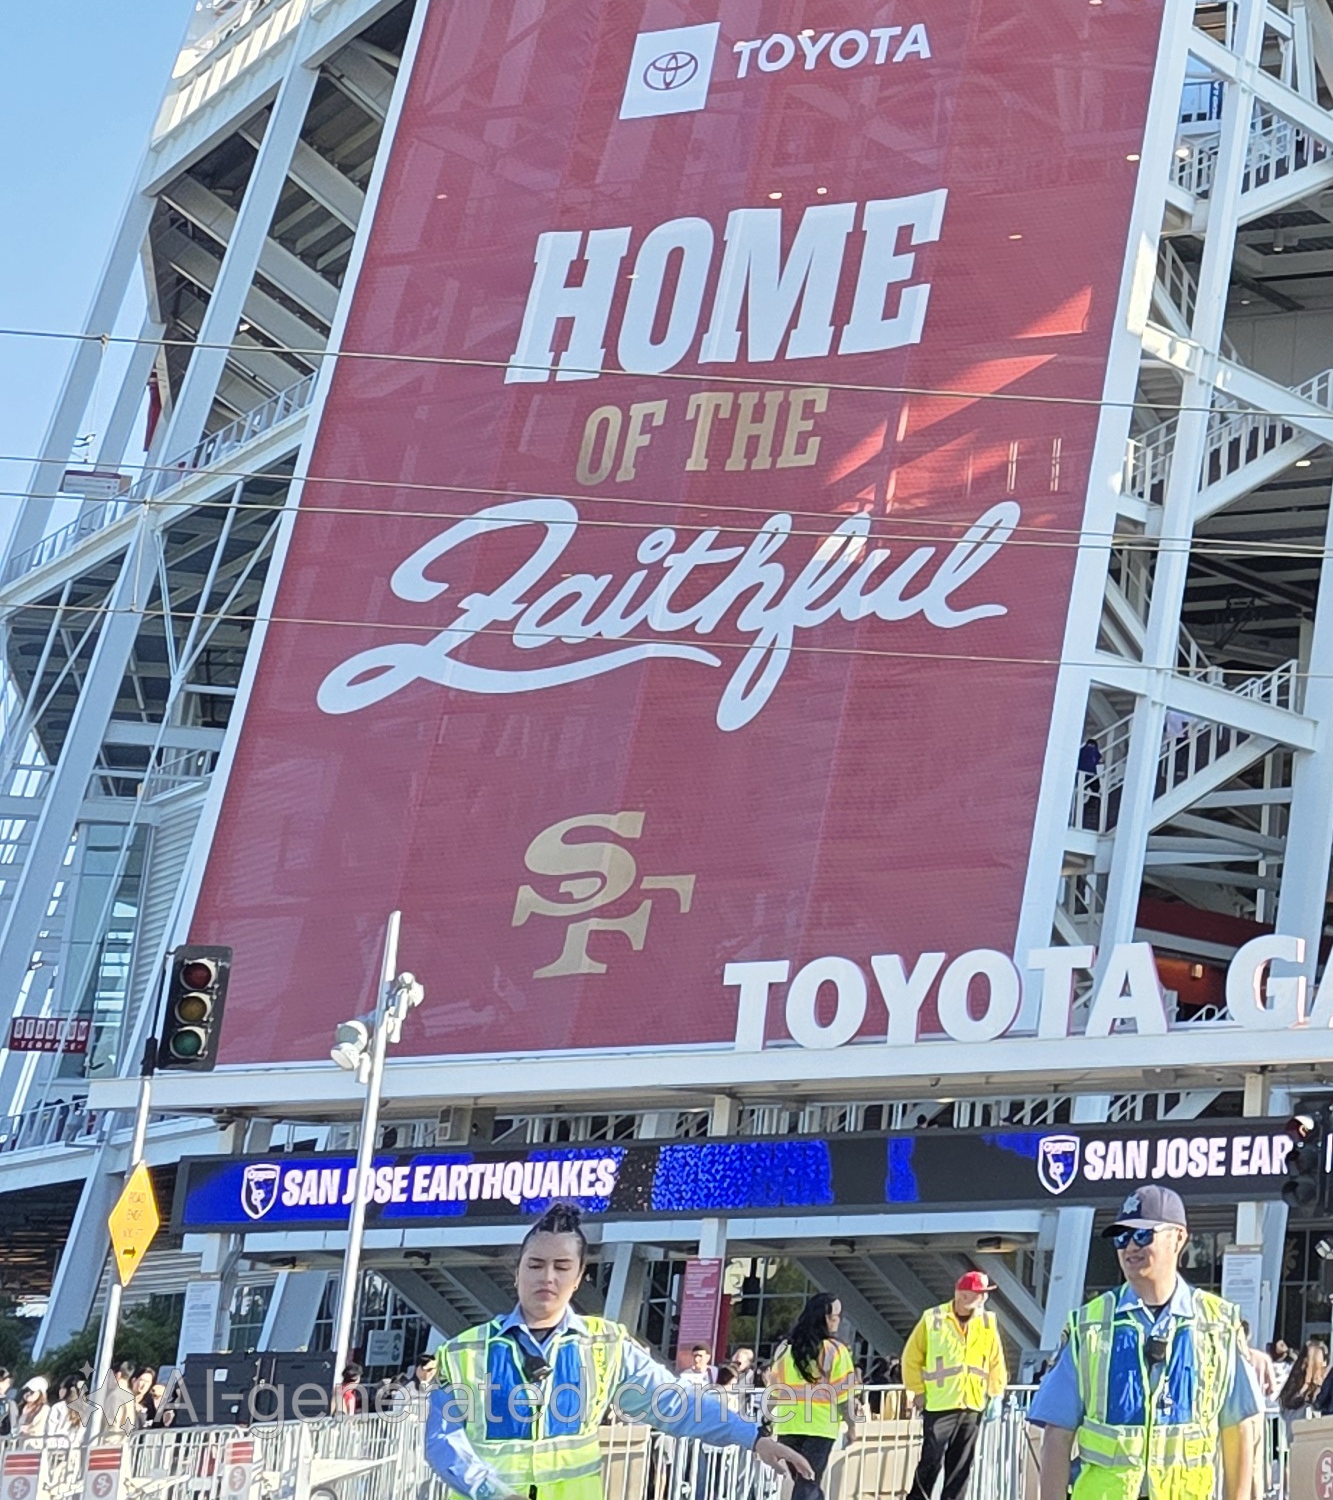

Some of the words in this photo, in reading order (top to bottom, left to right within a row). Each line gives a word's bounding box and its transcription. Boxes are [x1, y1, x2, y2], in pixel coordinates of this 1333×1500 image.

[733, 23, 931, 78] TOYOTA
[504, 188, 948, 384] HOME
[576, 400, 668, 486] OF
[686, 387, 829, 471] THE
[316, 497, 1021, 732] Faithful
[511, 811, 695, 979] SF
[724, 942, 1171, 1051] TOYOTA
[282, 1168, 340, 1207] SAN
[411, 1159, 617, 1203] EARTHQUAKES
[1084, 1139, 1147, 1181] SAN
[1151, 1137, 1227, 1179] JOSE
